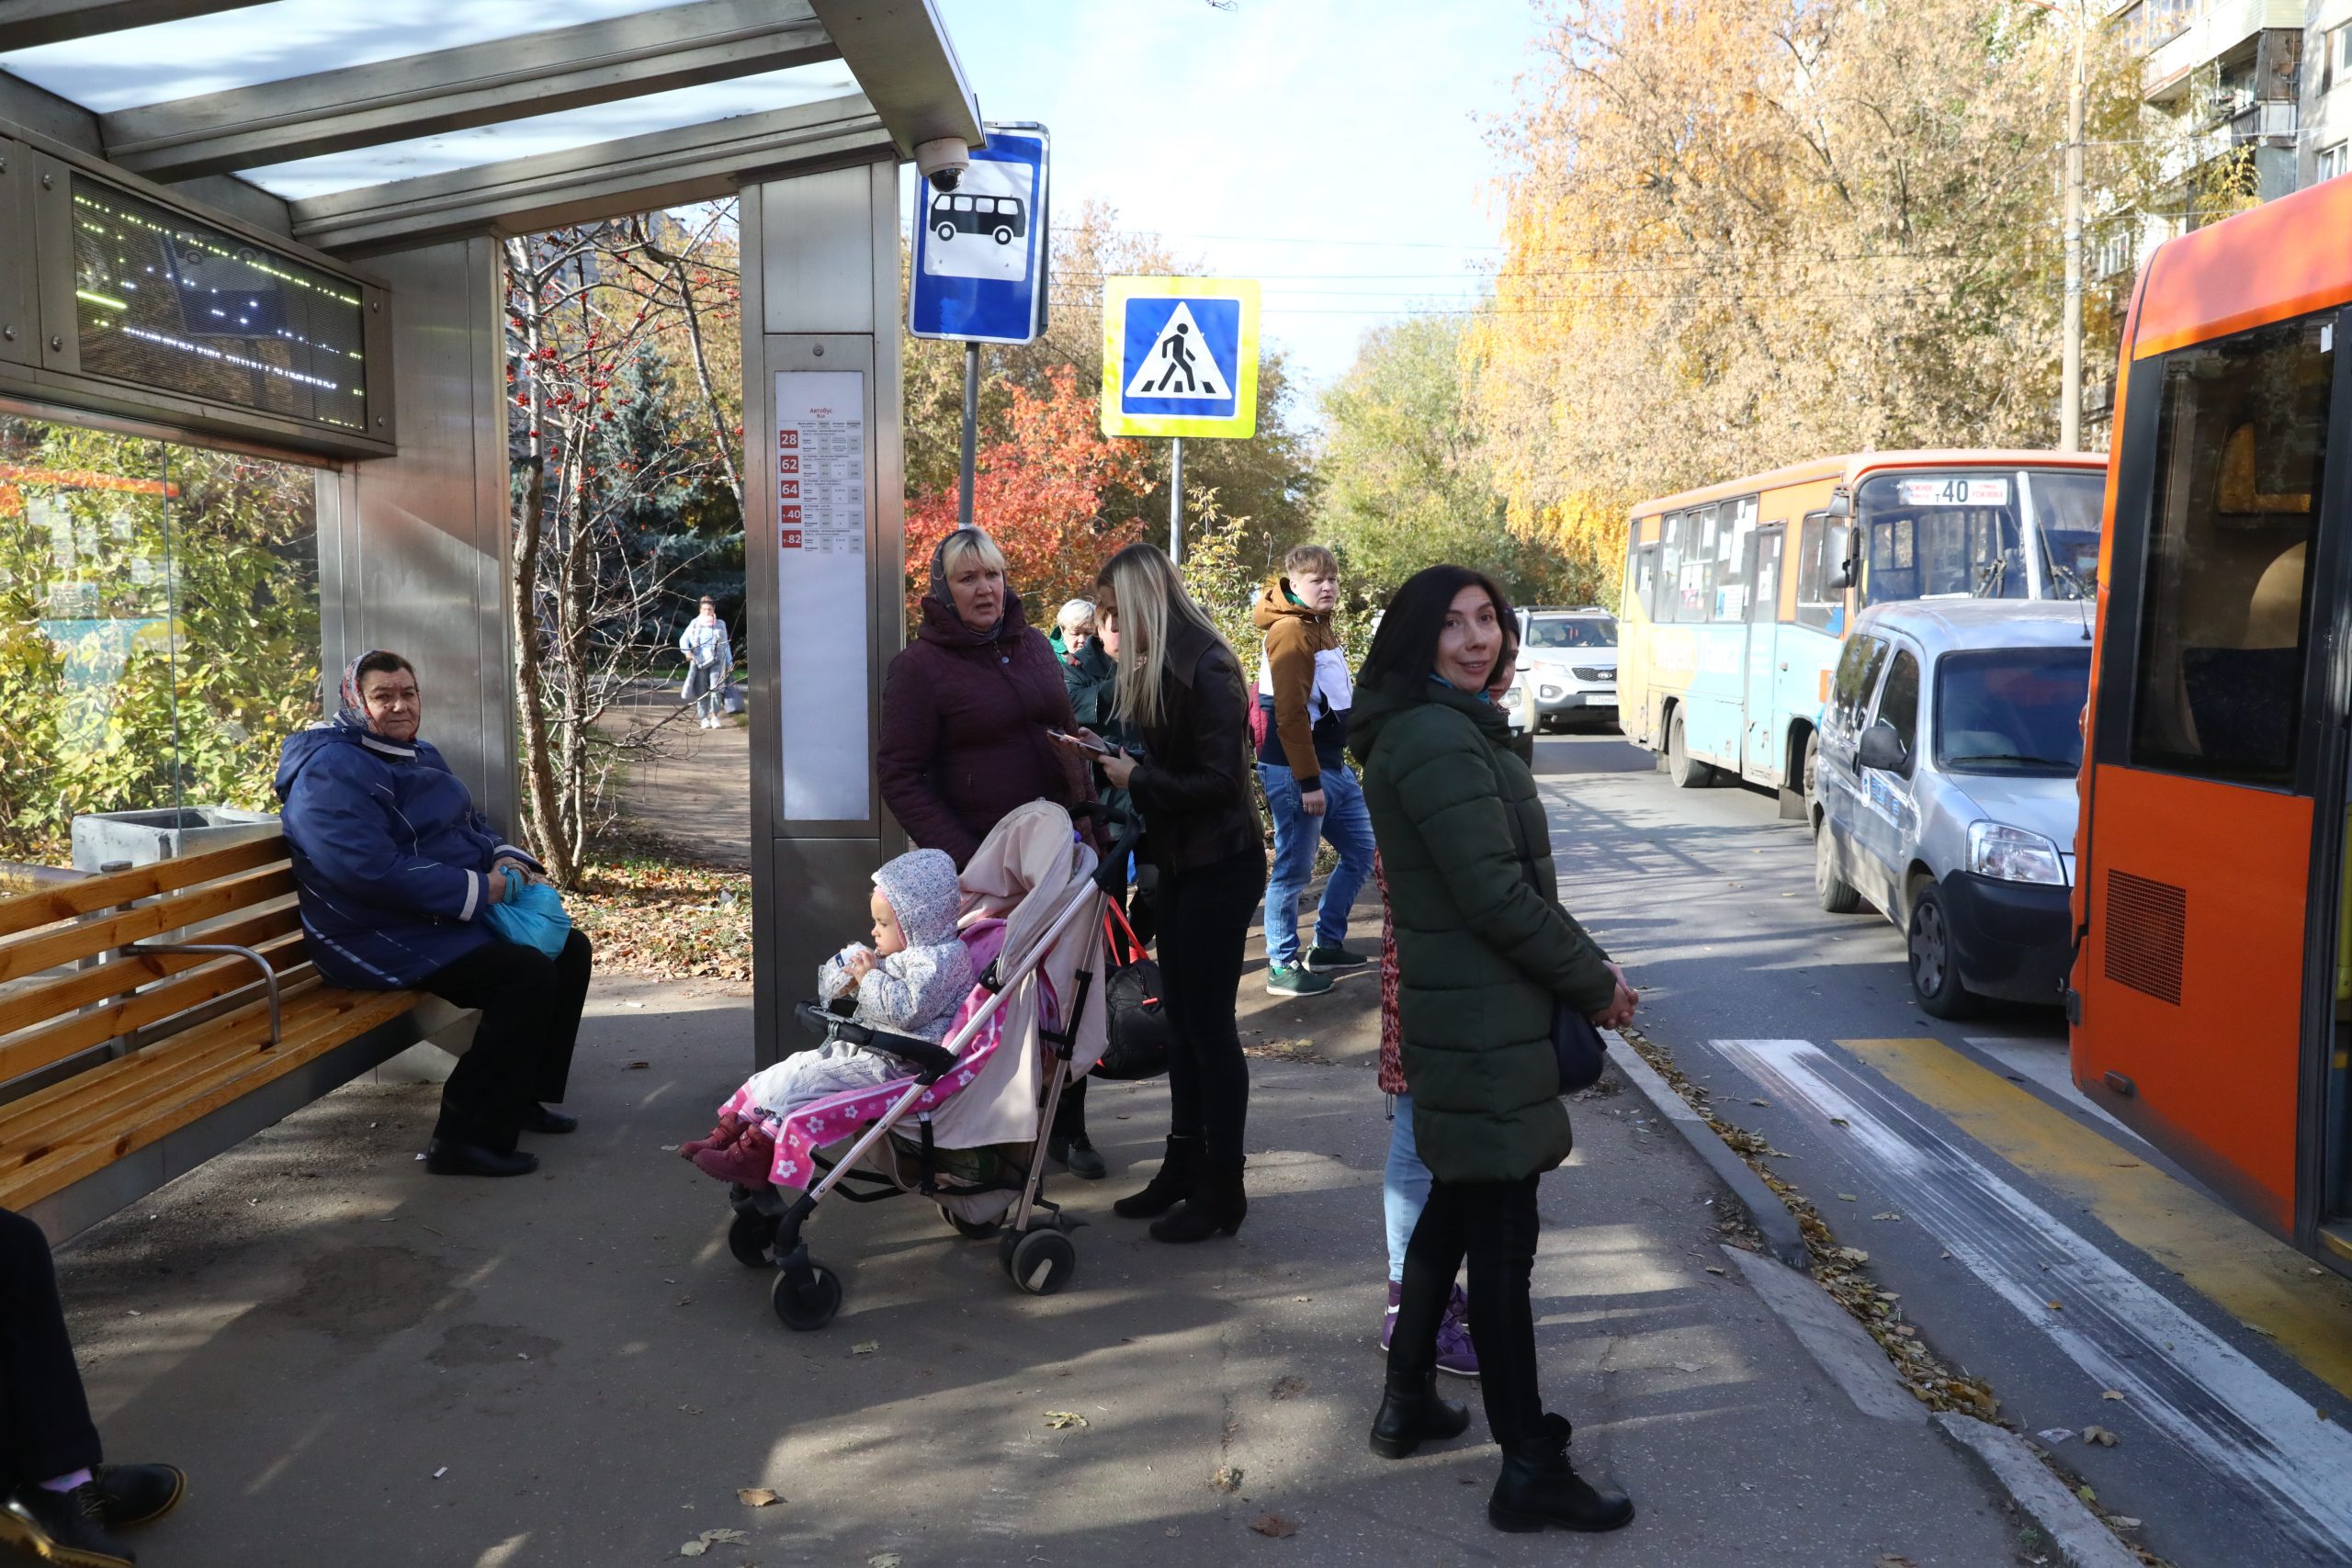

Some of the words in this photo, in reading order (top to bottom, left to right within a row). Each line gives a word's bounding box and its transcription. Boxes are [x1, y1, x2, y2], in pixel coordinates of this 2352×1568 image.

[781, 434, 797, 445] 28
[782, 459, 797, 470] 62
[782, 484, 798, 495] 64
